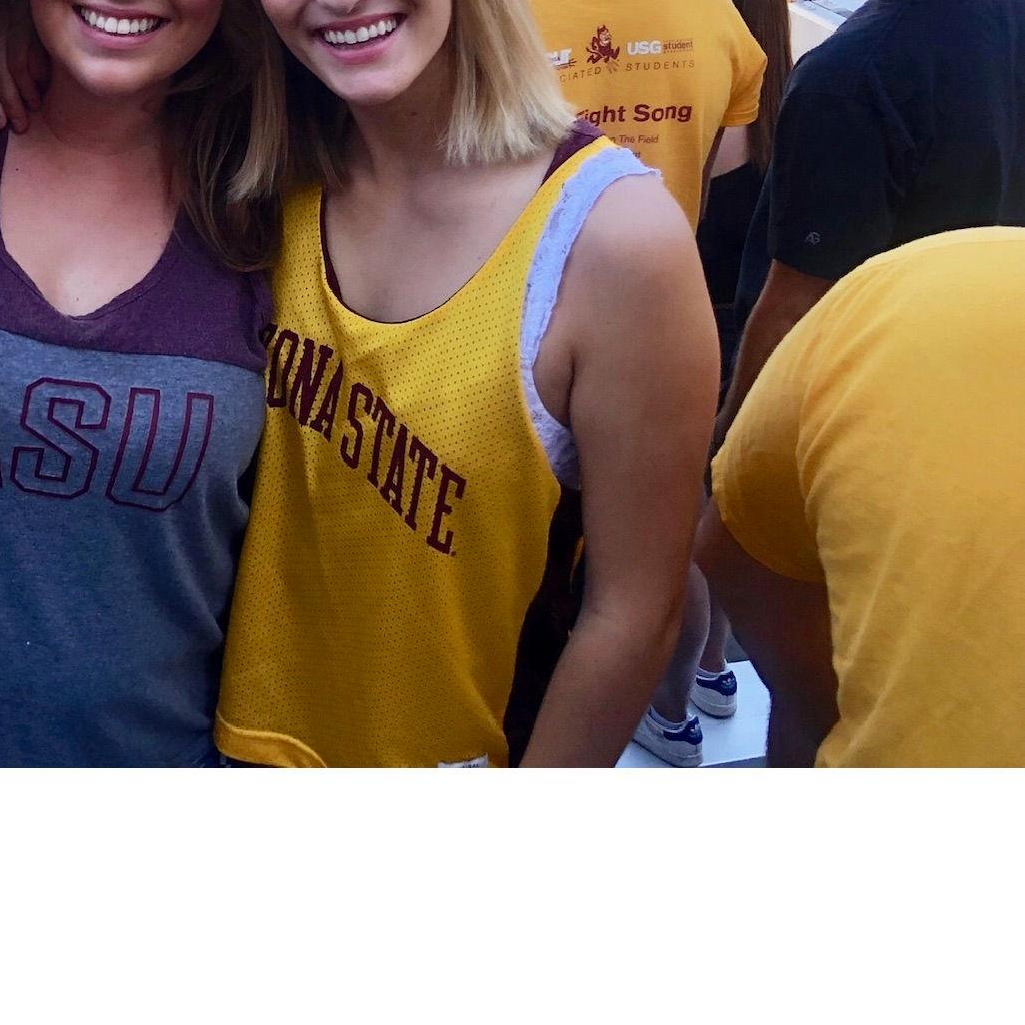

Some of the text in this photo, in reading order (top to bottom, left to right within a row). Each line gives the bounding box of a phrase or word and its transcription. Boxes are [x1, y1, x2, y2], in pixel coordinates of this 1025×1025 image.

[627, 40, 694, 56] USG student
[625, 59, 695, 72] STUDENTS
[633, 103, 693, 123] Song
[619, 134, 636, 144] The
[638, 134, 659, 144] Field
[339, 382, 467, 555] STATE
